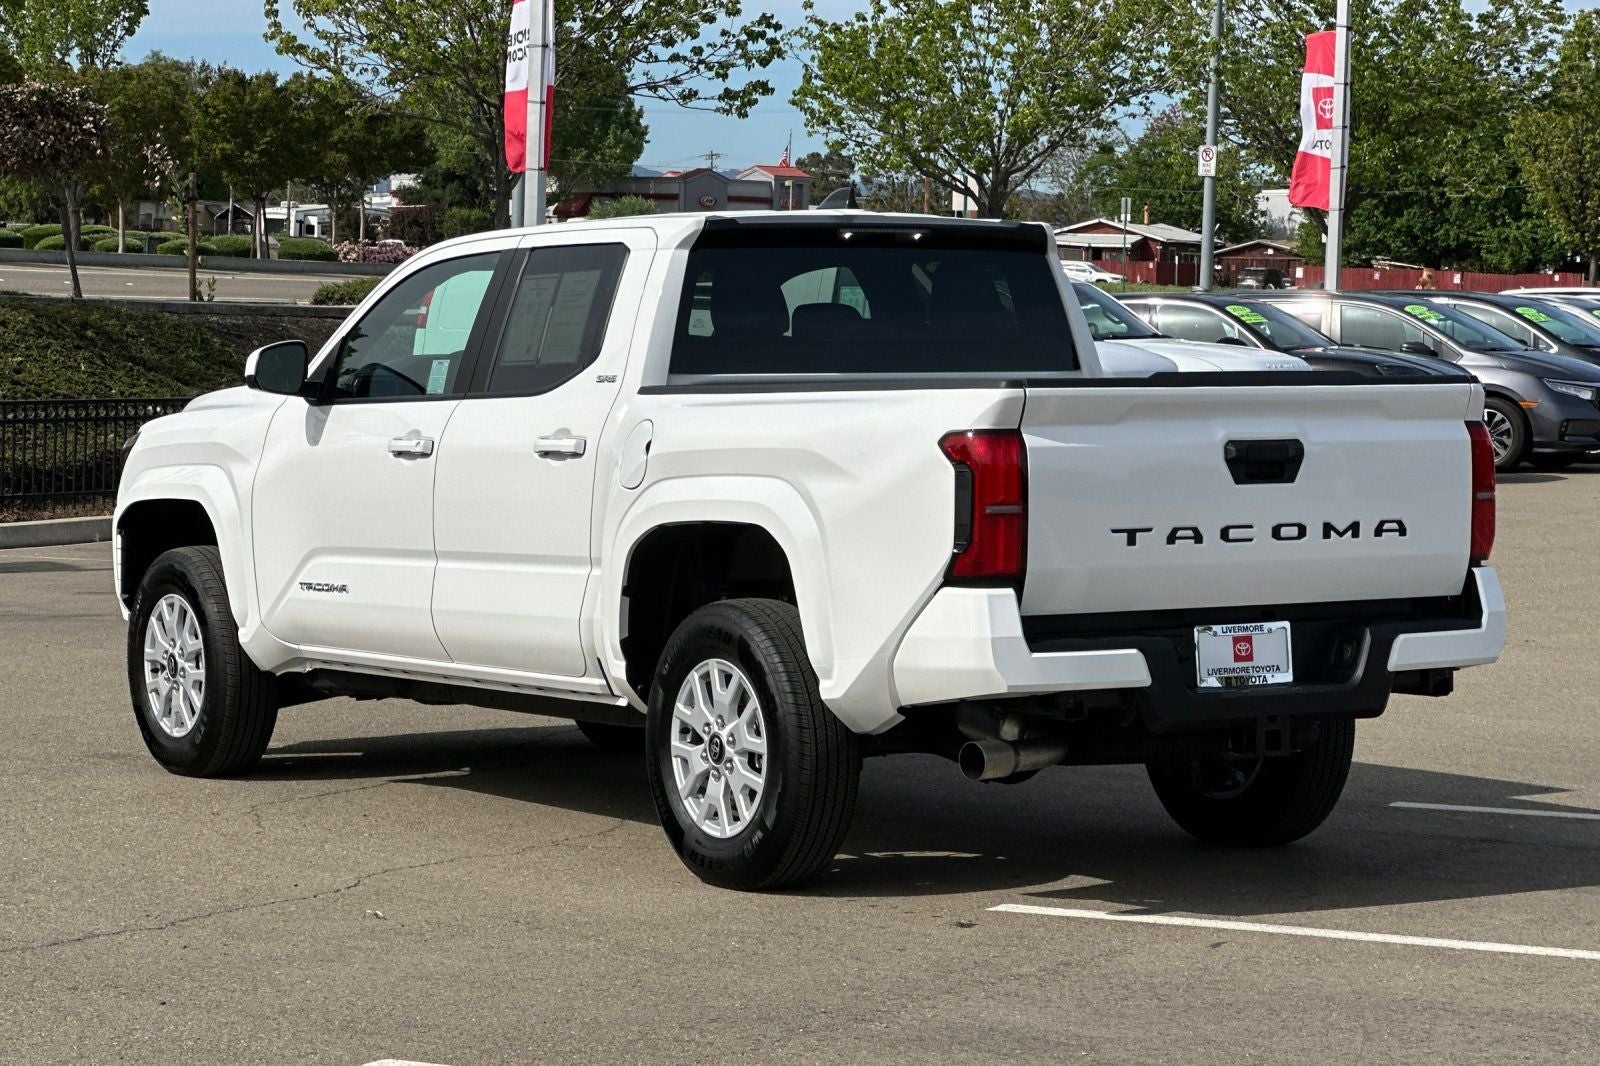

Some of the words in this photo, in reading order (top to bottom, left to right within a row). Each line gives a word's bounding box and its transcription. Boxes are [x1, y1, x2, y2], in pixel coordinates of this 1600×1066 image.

[1110, 519, 1408, 547] TACOMA
[299, 582, 349, 593] TACOMA
[1221, 624, 1265, 634] LIVERMORE
[1235, 675, 1269, 685] TOYOTA
